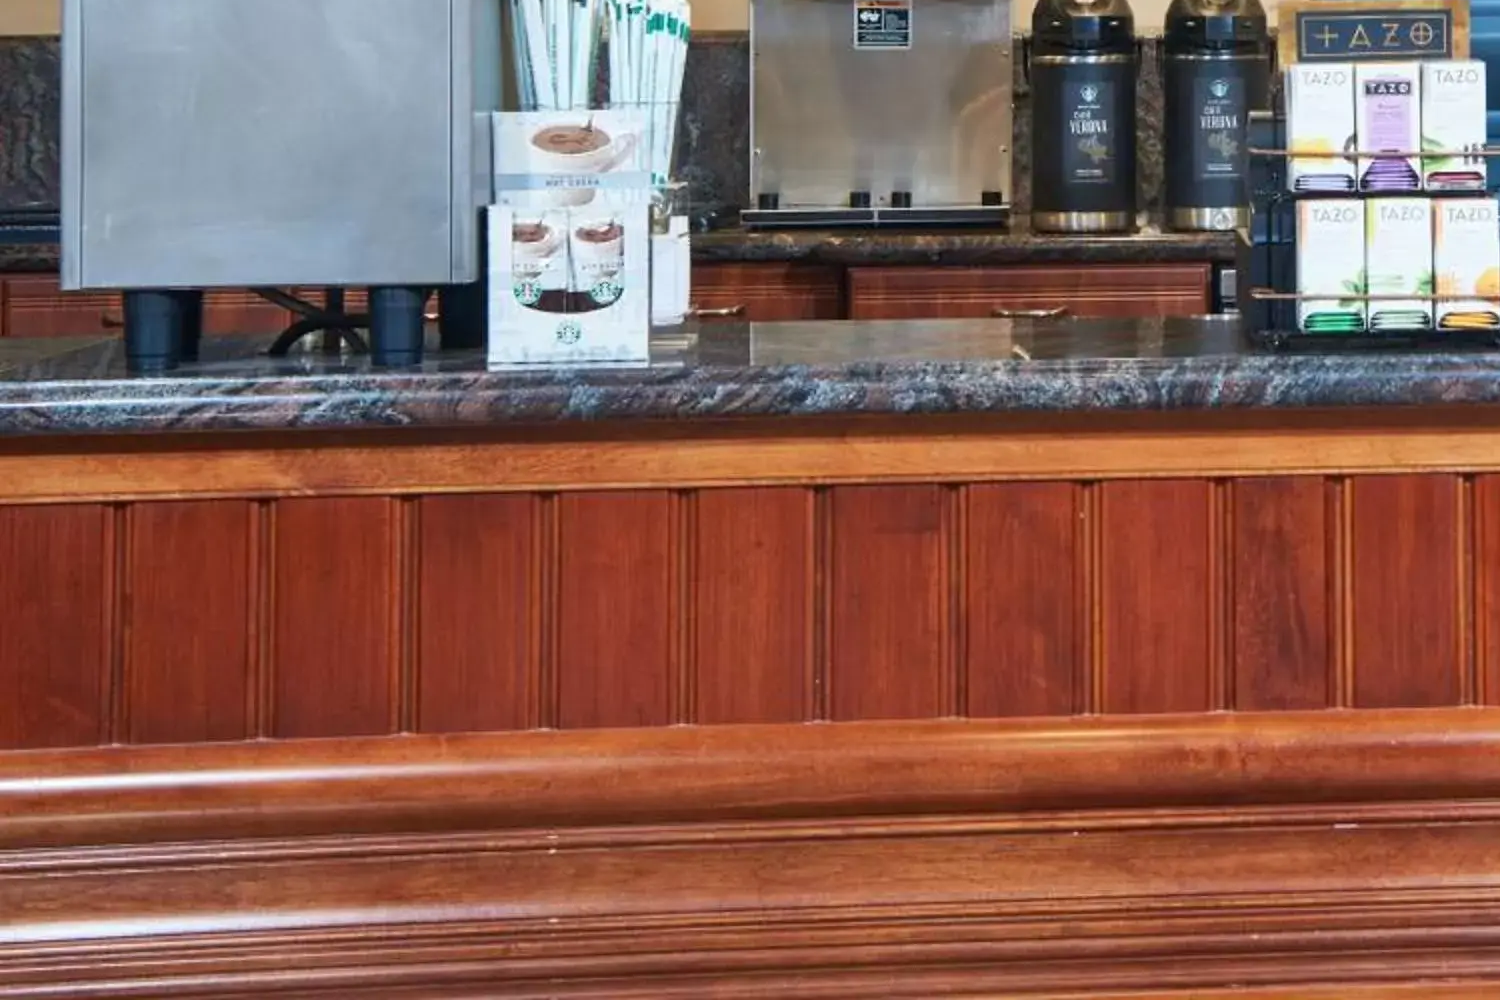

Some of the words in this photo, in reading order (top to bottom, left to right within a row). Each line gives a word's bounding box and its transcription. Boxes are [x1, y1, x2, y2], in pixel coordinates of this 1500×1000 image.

[1302, 71, 1347, 87] TAZO
[1435, 69, 1479, 84] TAZO
[1371, 82, 1409, 93] TAZO
[1312, 207, 1357, 223] TAZO
[1380, 206, 1425, 222] TAZO
[1446, 207, 1493, 223] TAZO
